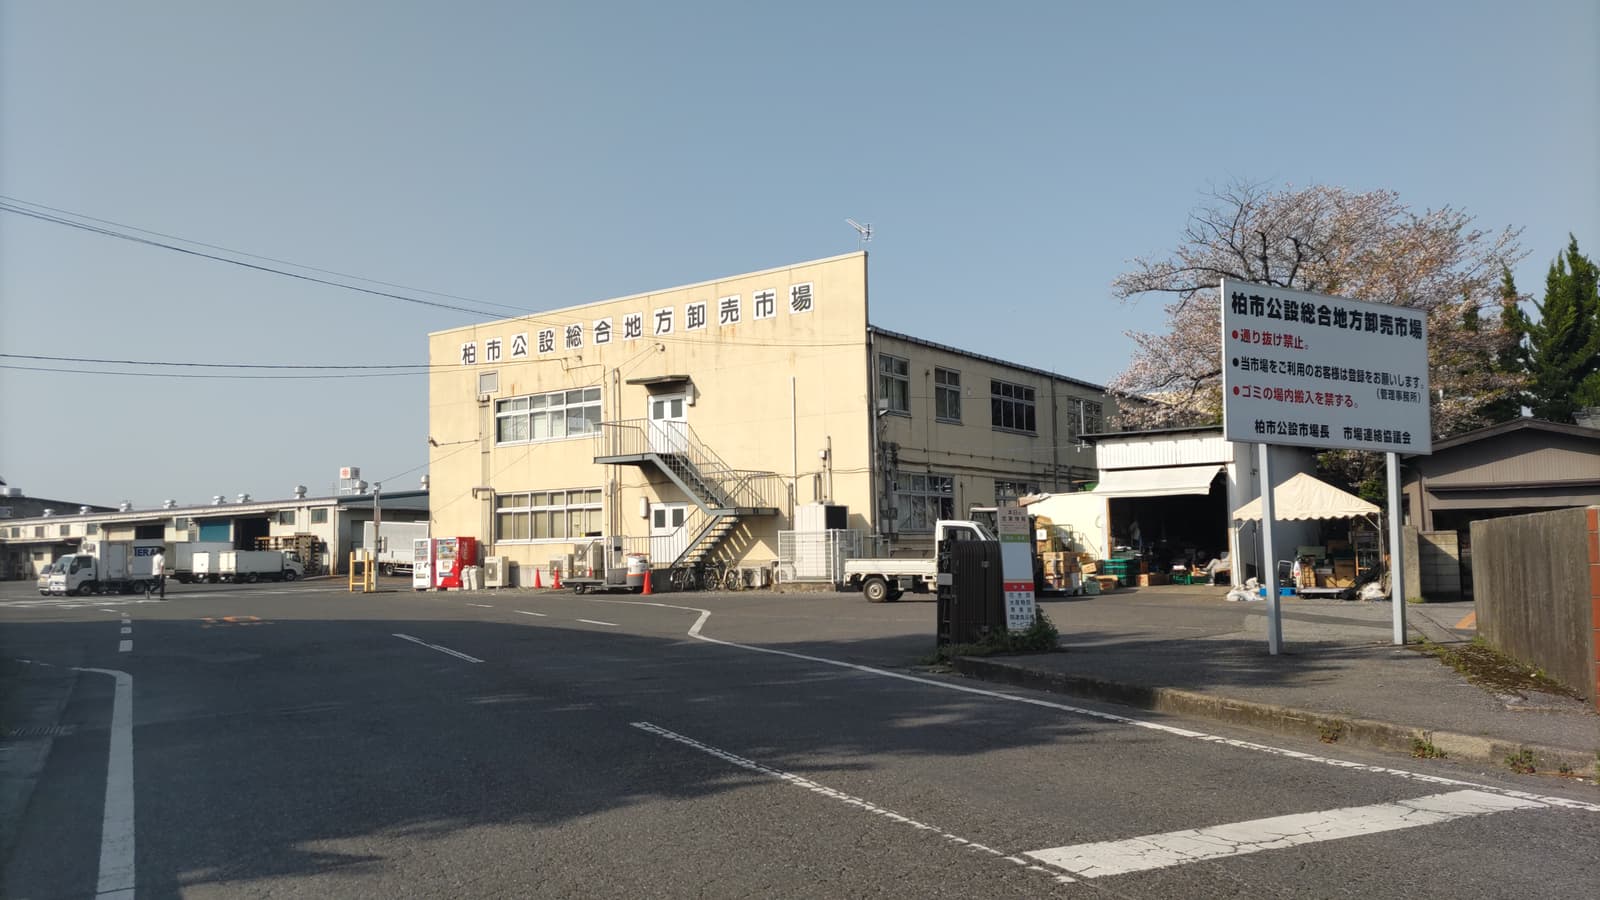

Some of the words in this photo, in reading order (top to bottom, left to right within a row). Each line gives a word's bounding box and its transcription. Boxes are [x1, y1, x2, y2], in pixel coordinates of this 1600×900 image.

[461, 284, 812, 365] 柏市公設総合地方卸売市場
[1231, 291, 1423, 339] 柏市公設総合地方卸売市場
[1240, 328, 1309, 350] 通り抜け禁止。
[1240, 355, 1425, 390] 当市場をご利用のお客様は登録をお願いします。
[1254, 418, 1330, 439] 柏市公設市場長
[1342, 426, 1412, 445] 市場連絡協議会
